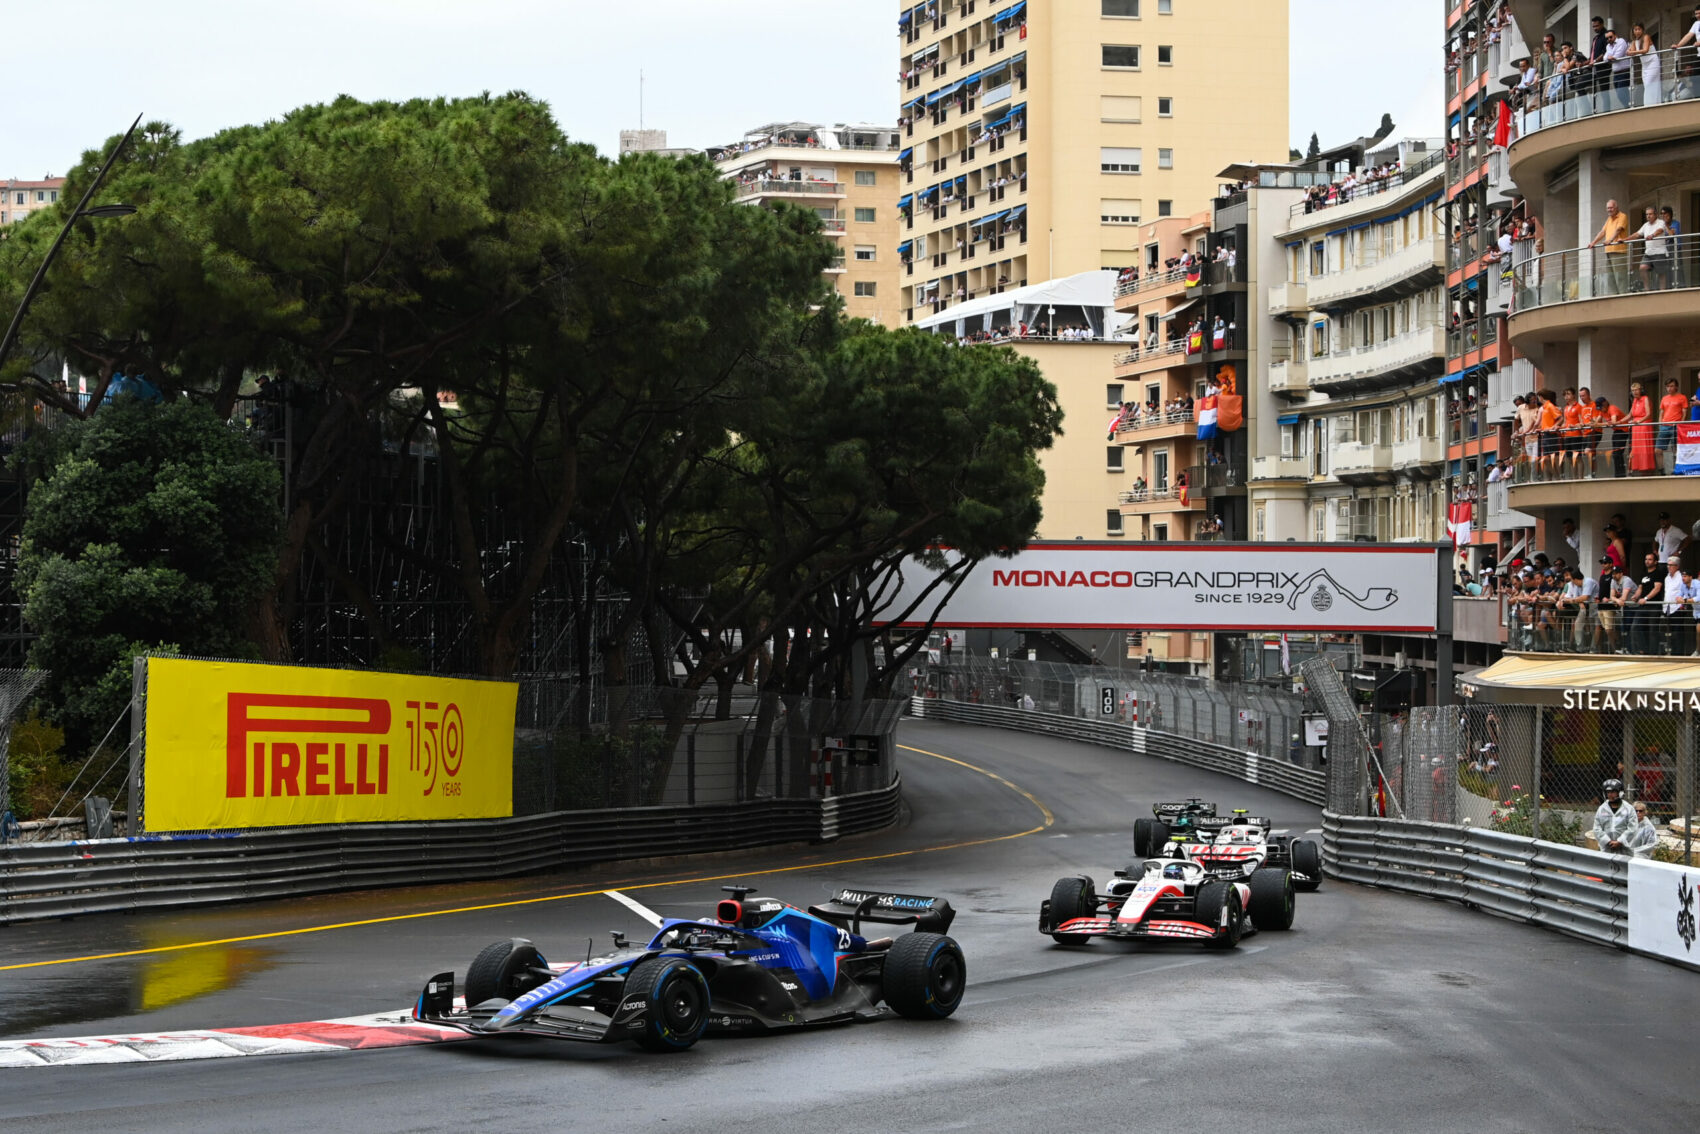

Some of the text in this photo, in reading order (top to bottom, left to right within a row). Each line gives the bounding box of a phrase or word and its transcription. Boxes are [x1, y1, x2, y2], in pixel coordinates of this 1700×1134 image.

[1194, 593, 1284, 603] SINCE 1929
[1104, 689, 1112, 713] 100
[1563, 689, 1632, 711] STEAK
[1637, 694, 1648, 708] N
[226, 692, 464, 798] PIRELLI 150
[442, 782, 462, 796] YEARS
[893, 897, 934, 908] RACING
[837, 928, 851, 949] 23
